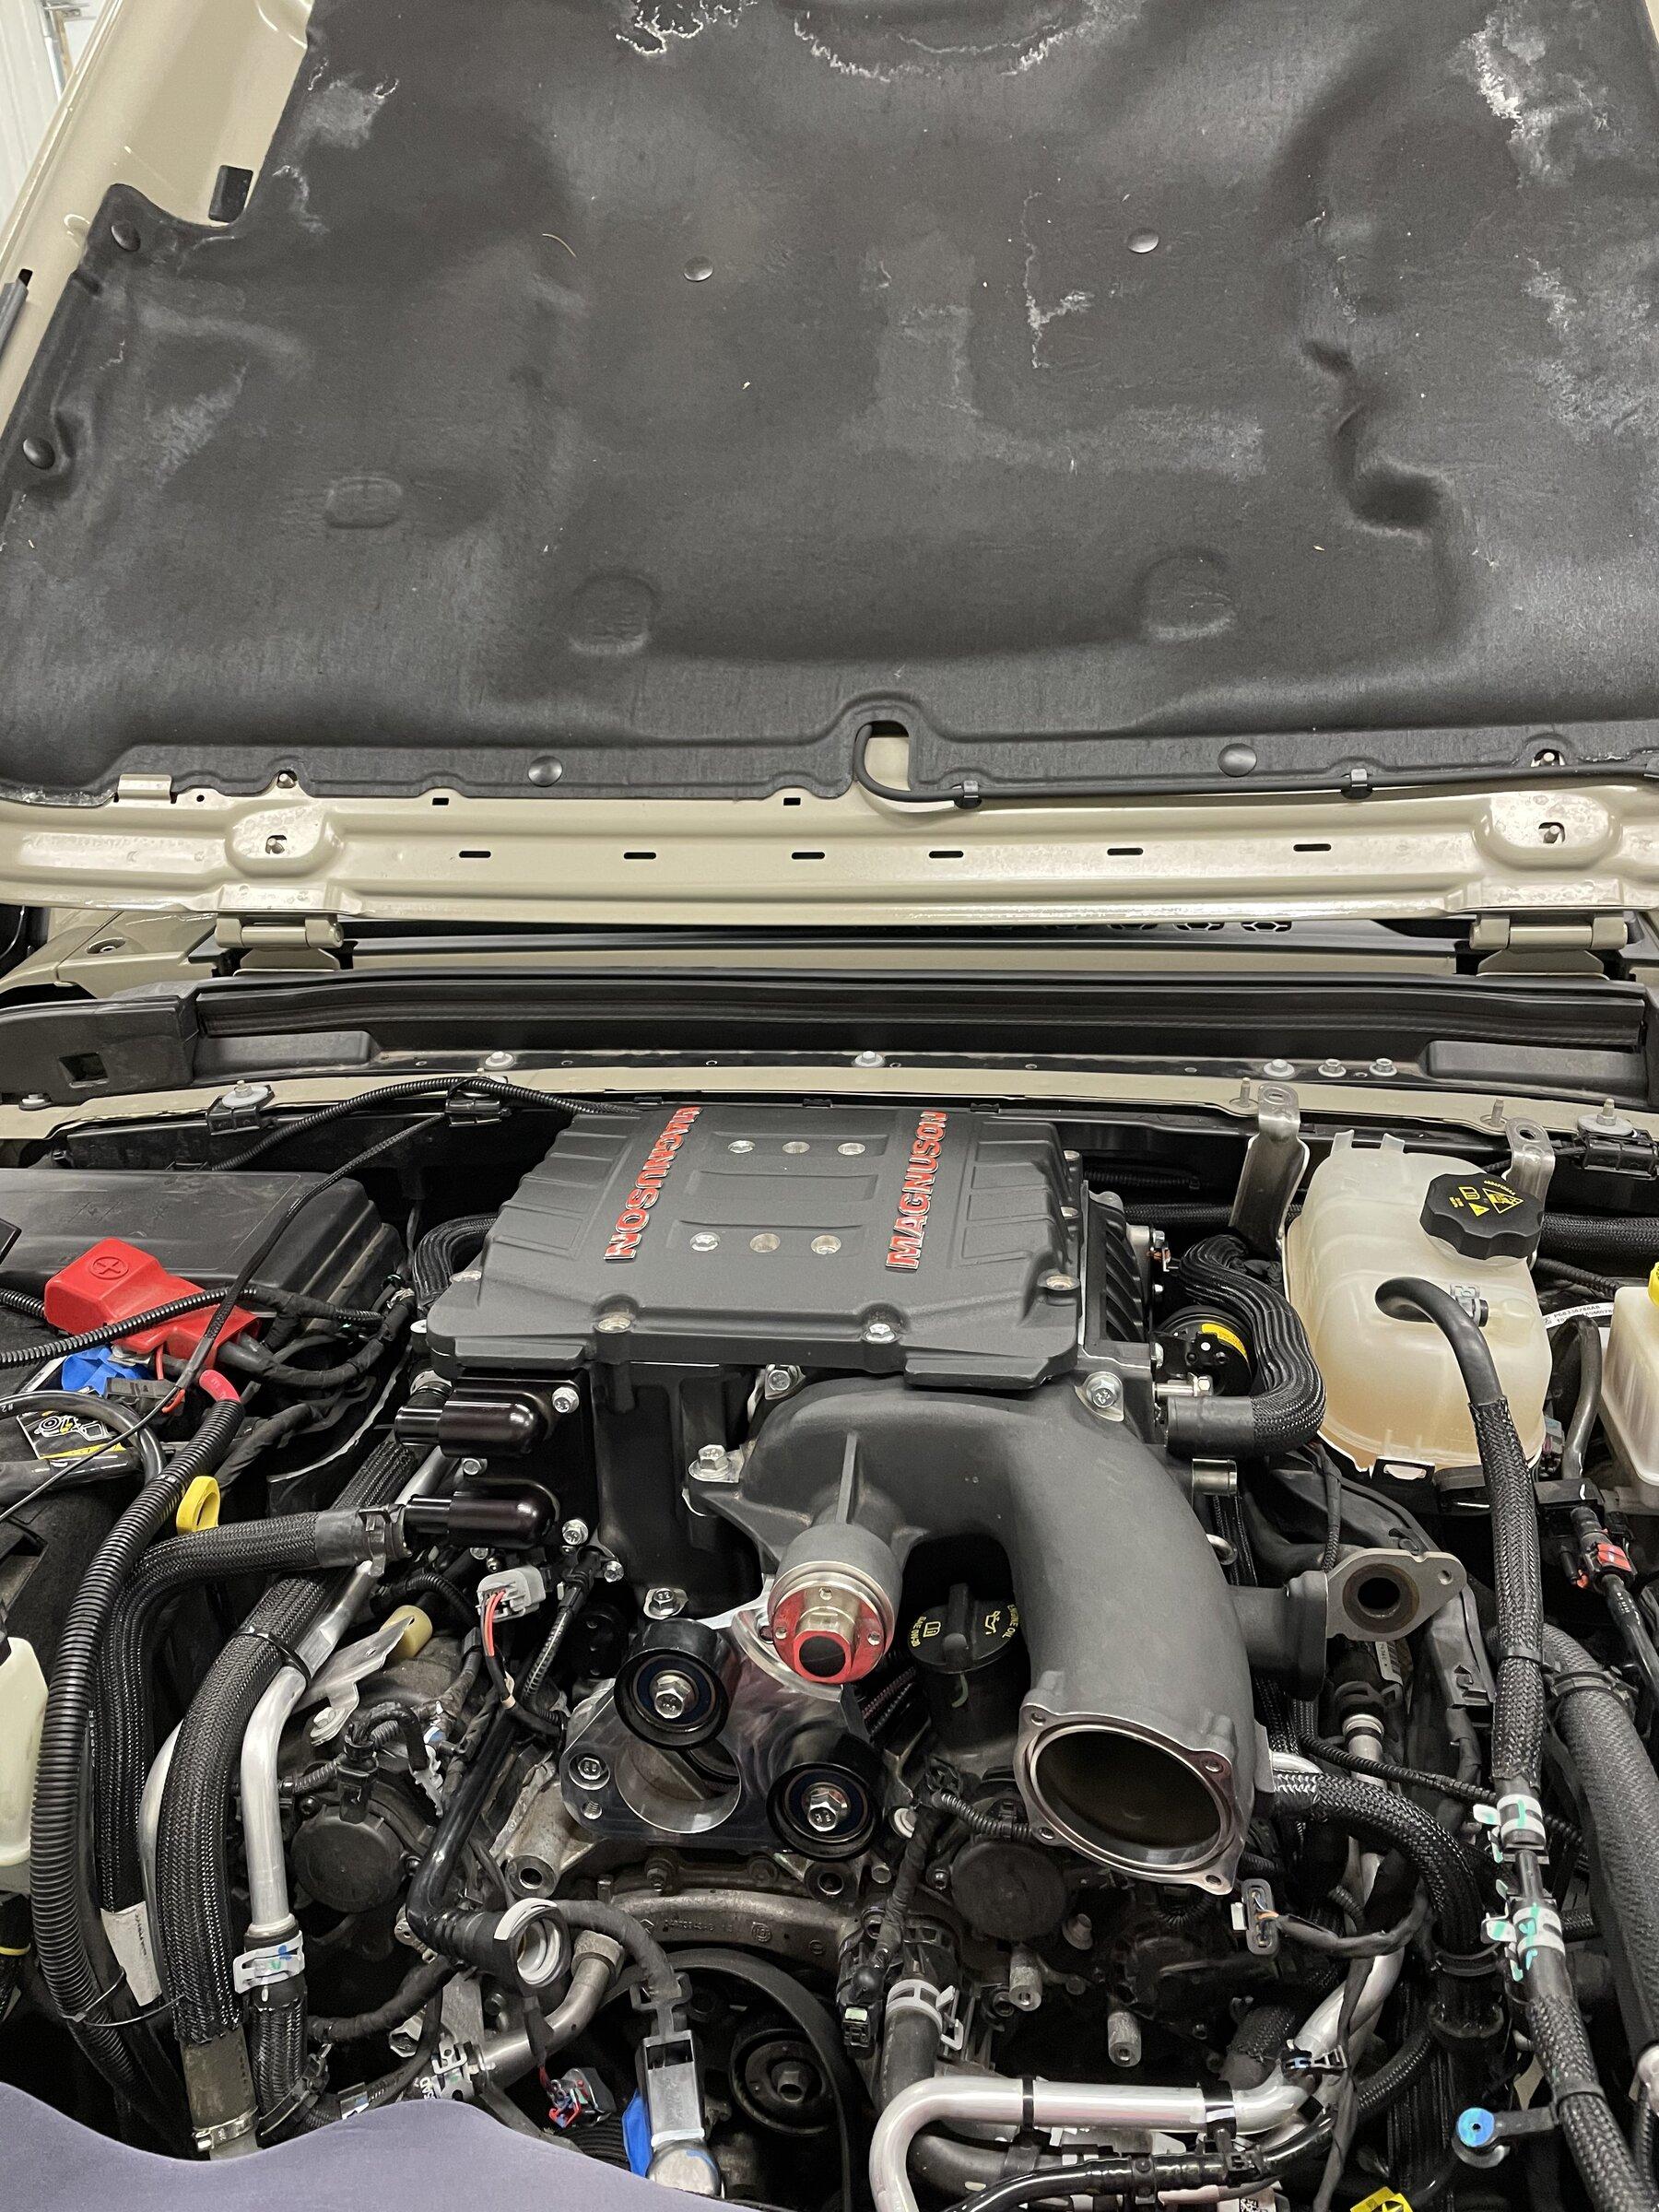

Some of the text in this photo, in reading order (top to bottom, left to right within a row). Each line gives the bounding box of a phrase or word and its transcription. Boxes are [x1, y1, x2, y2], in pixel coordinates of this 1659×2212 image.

[604, 1106, 702, 1261] MAGNUSON
[886, 1111, 948, 1270] MAGNUSON
[1002, 1628, 1016, 1639] OIL
